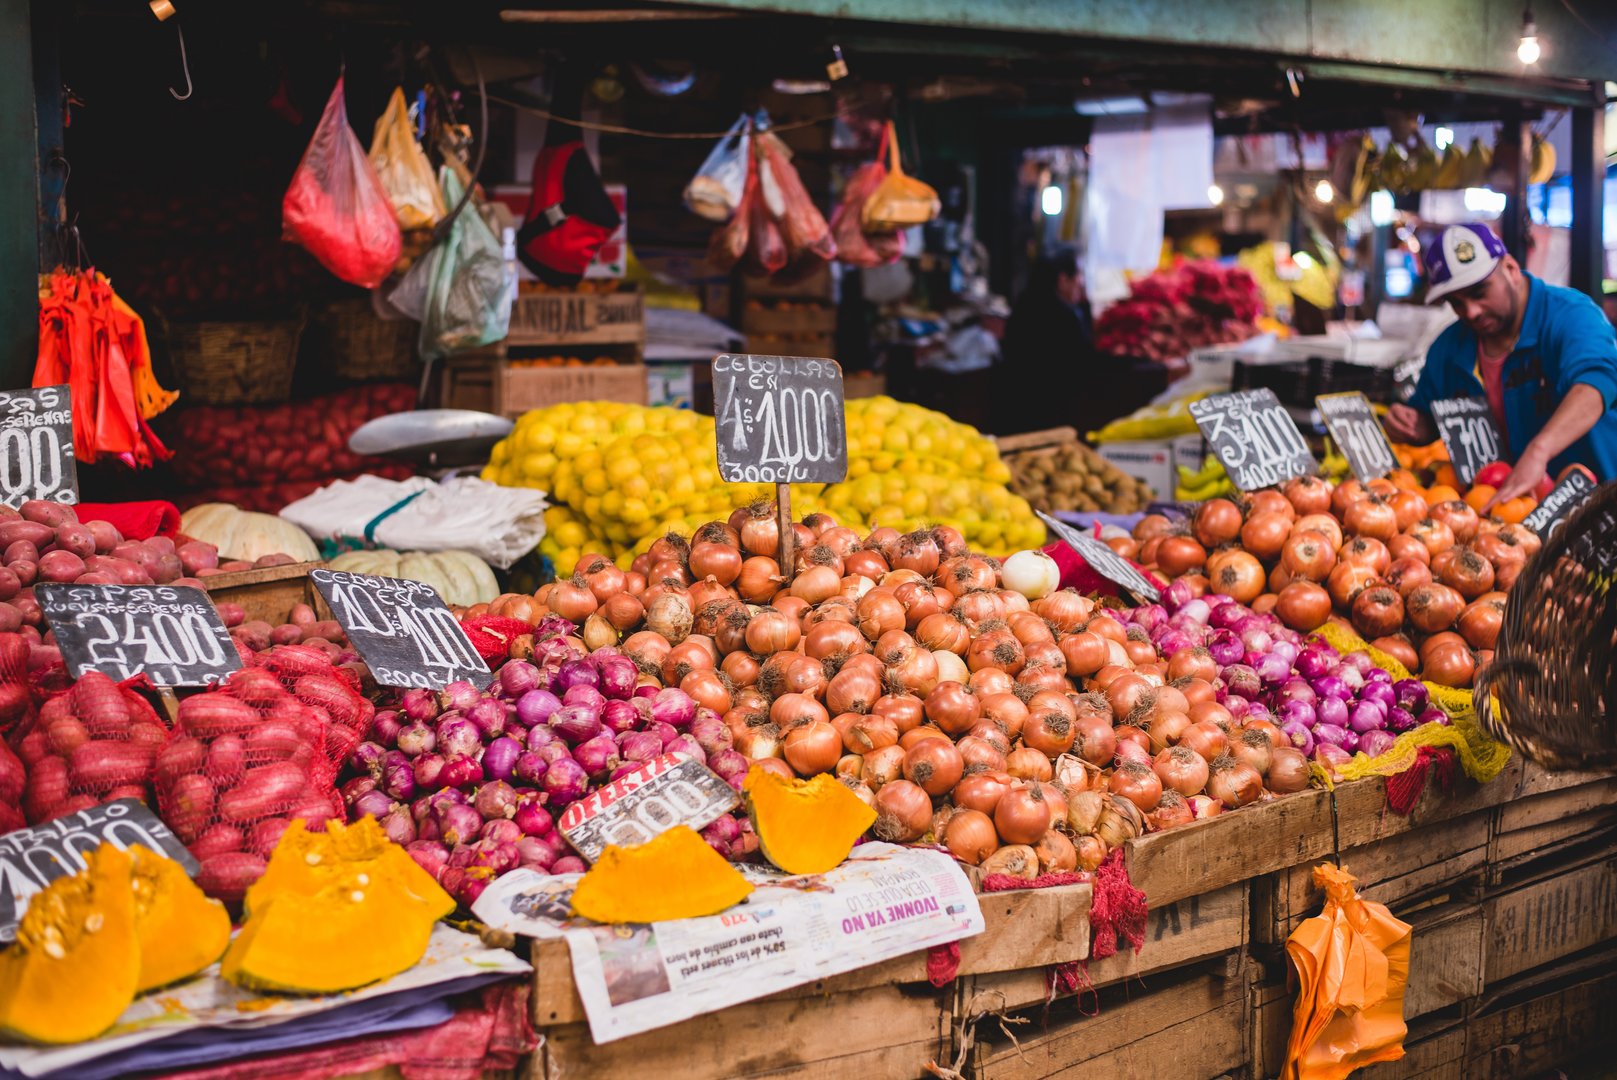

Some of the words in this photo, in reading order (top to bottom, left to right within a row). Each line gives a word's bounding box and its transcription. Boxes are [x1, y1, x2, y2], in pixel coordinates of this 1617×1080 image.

[560, 752, 682, 831] OFERTA
[865, 909, 887, 928] YA
[886, 895, 940, 922] IVONNE
[842, 915, 865, 935] NO
[735, 950, 749, 962] los
